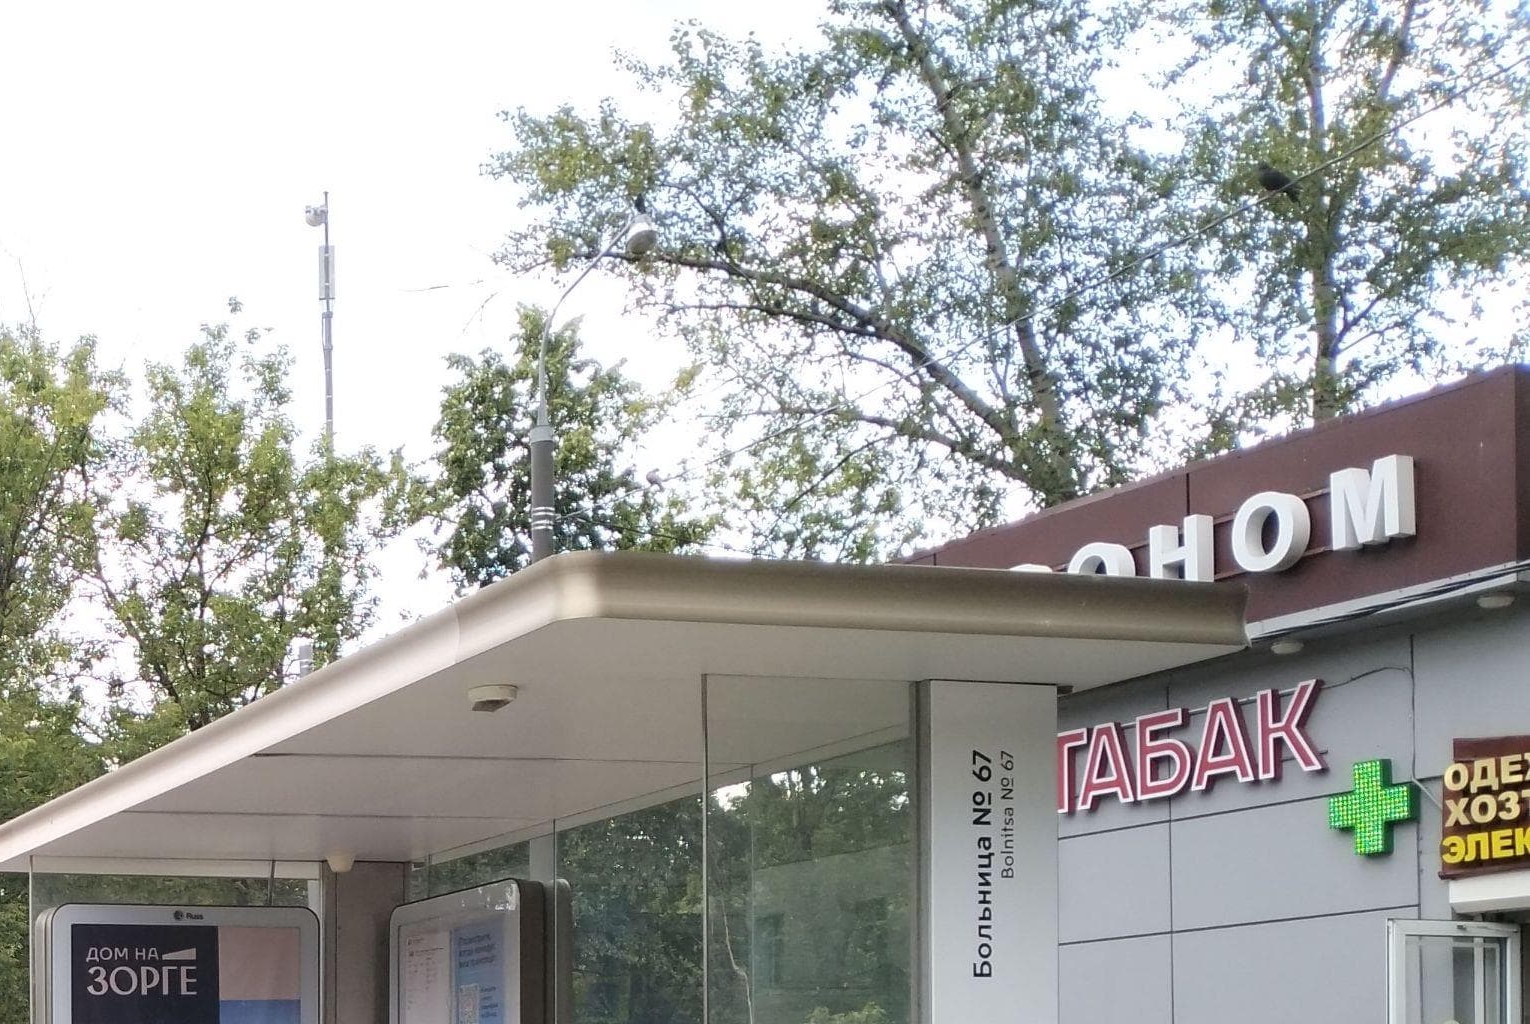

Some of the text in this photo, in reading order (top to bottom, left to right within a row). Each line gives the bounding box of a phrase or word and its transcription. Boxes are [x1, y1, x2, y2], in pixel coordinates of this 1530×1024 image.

[972, 750, 992, 783] 67
[1001, 751, 1014, 771] 67
[1444, 752, 1530, 794] ОДЕ
[1001, 806, 1014, 879] Bolnitsa
[973, 836, 995, 978] Больница
[86, 947, 159, 962] ДОМ НА
[86, 966, 198, 996] ЗОРГЕ
